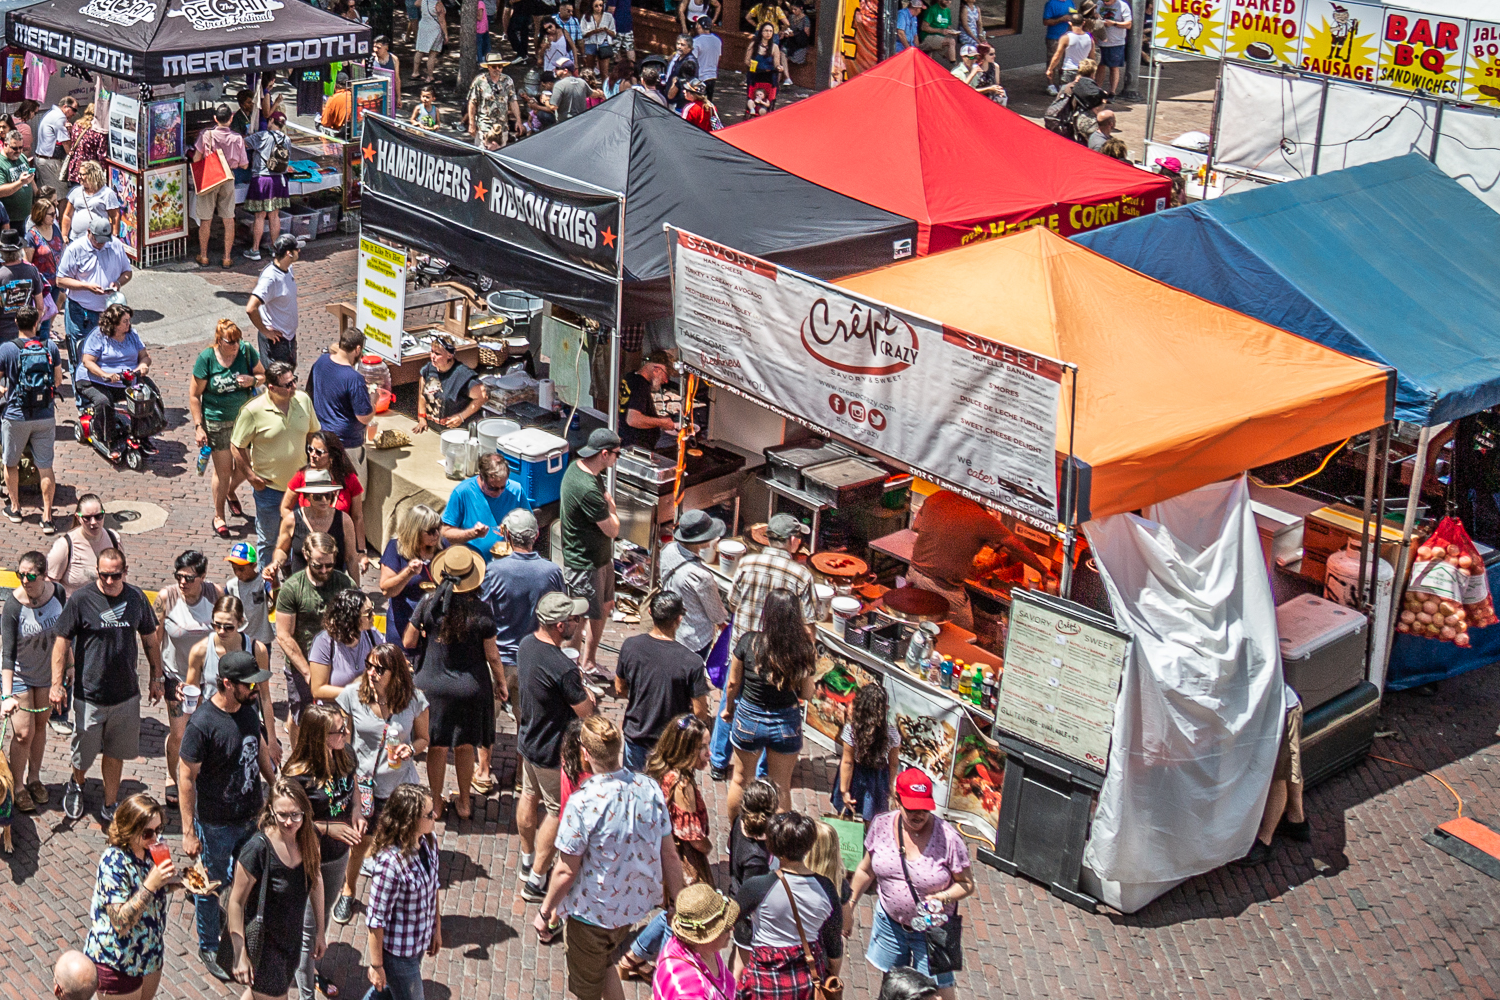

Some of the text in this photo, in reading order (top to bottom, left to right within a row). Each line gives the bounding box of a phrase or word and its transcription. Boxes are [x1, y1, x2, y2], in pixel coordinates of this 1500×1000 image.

[219, 2, 236, 11] The
[194, 11, 275, 30] Street Festival
[1230, 10, 1297, 39] POTATO
[1385, 13, 1460, 51] BAR
[13, 22, 134, 76] MERCH BOOTH
[162, 34, 356, 78] MERCH BOOTH
[1303, 56, 1374, 82] SAUSAGE
[1379, 67, 1457, 94] SANDWICHES
[376, 138, 598, 250] HAMBURGERS RIBBON FRIES
[1069, 201, 1120, 230] CORN
[374, 246, 384, 256] Like
[687, 235, 759, 271] SAVORY
[367, 260, 396, 277] Hamburgers
[703, 257, 744, 276] HAM CHEESE
[365, 278, 397, 298] Ribbon Fries
[685, 266, 763, 300] TURKEY CREAMY AVOCADO
[685, 286, 731, 308] MEDITERRANEAN
[731, 303, 753, 317] MEDLEY
[693, 310, 717, 323] CHICKEN
[718, 318, 735, 330] BASIL
[810, 297, 898, 356] Crêpe
[679, 326, 728, 354] TAKE SOME
[881, 340, 919, 365] CRAZY
[966, 335, 1042, 372] SWEET
[722, 367, 768, 393] WITH YOU
[830, 368, 867, 383] SAVORY
[874, 374, 902, 384] SWEET
[972, 354, 1036, 381] NUTELLA BANANA
[818, 379, 897, 413] www.crepecrazy.com
[988, 382, 1020, 398] S'MORES
[960, 395, 1044, 432] DULCE DE LECHE TURTLE
[798, 417, 807, 427] TX
[808, 423, 831, 438] 78620
[836, 416, 880, 440] #crepecrazy
[960, 417, 1042, 454] SWEET CHEESE DELIGHT
[957, 455, 972, 466] we
[966, 467, 997, 485] cater
[909, 466, 927, 480] 3103
[936, 478, 962, 494] Lamar
[1016, 510, 1028, 523] TX
[1029, 515, 1057, 535] 78704
[989, 487, 1057, 521] all occasions
[24, 622, 44, 634] GOOD
[100, 620, 131, 628] HONDA
[1019, 610, 1053, 628] SAVORY
[1084, 634, 1114, 651] SWEET
[1026, 716, 1038, 727] FREE
